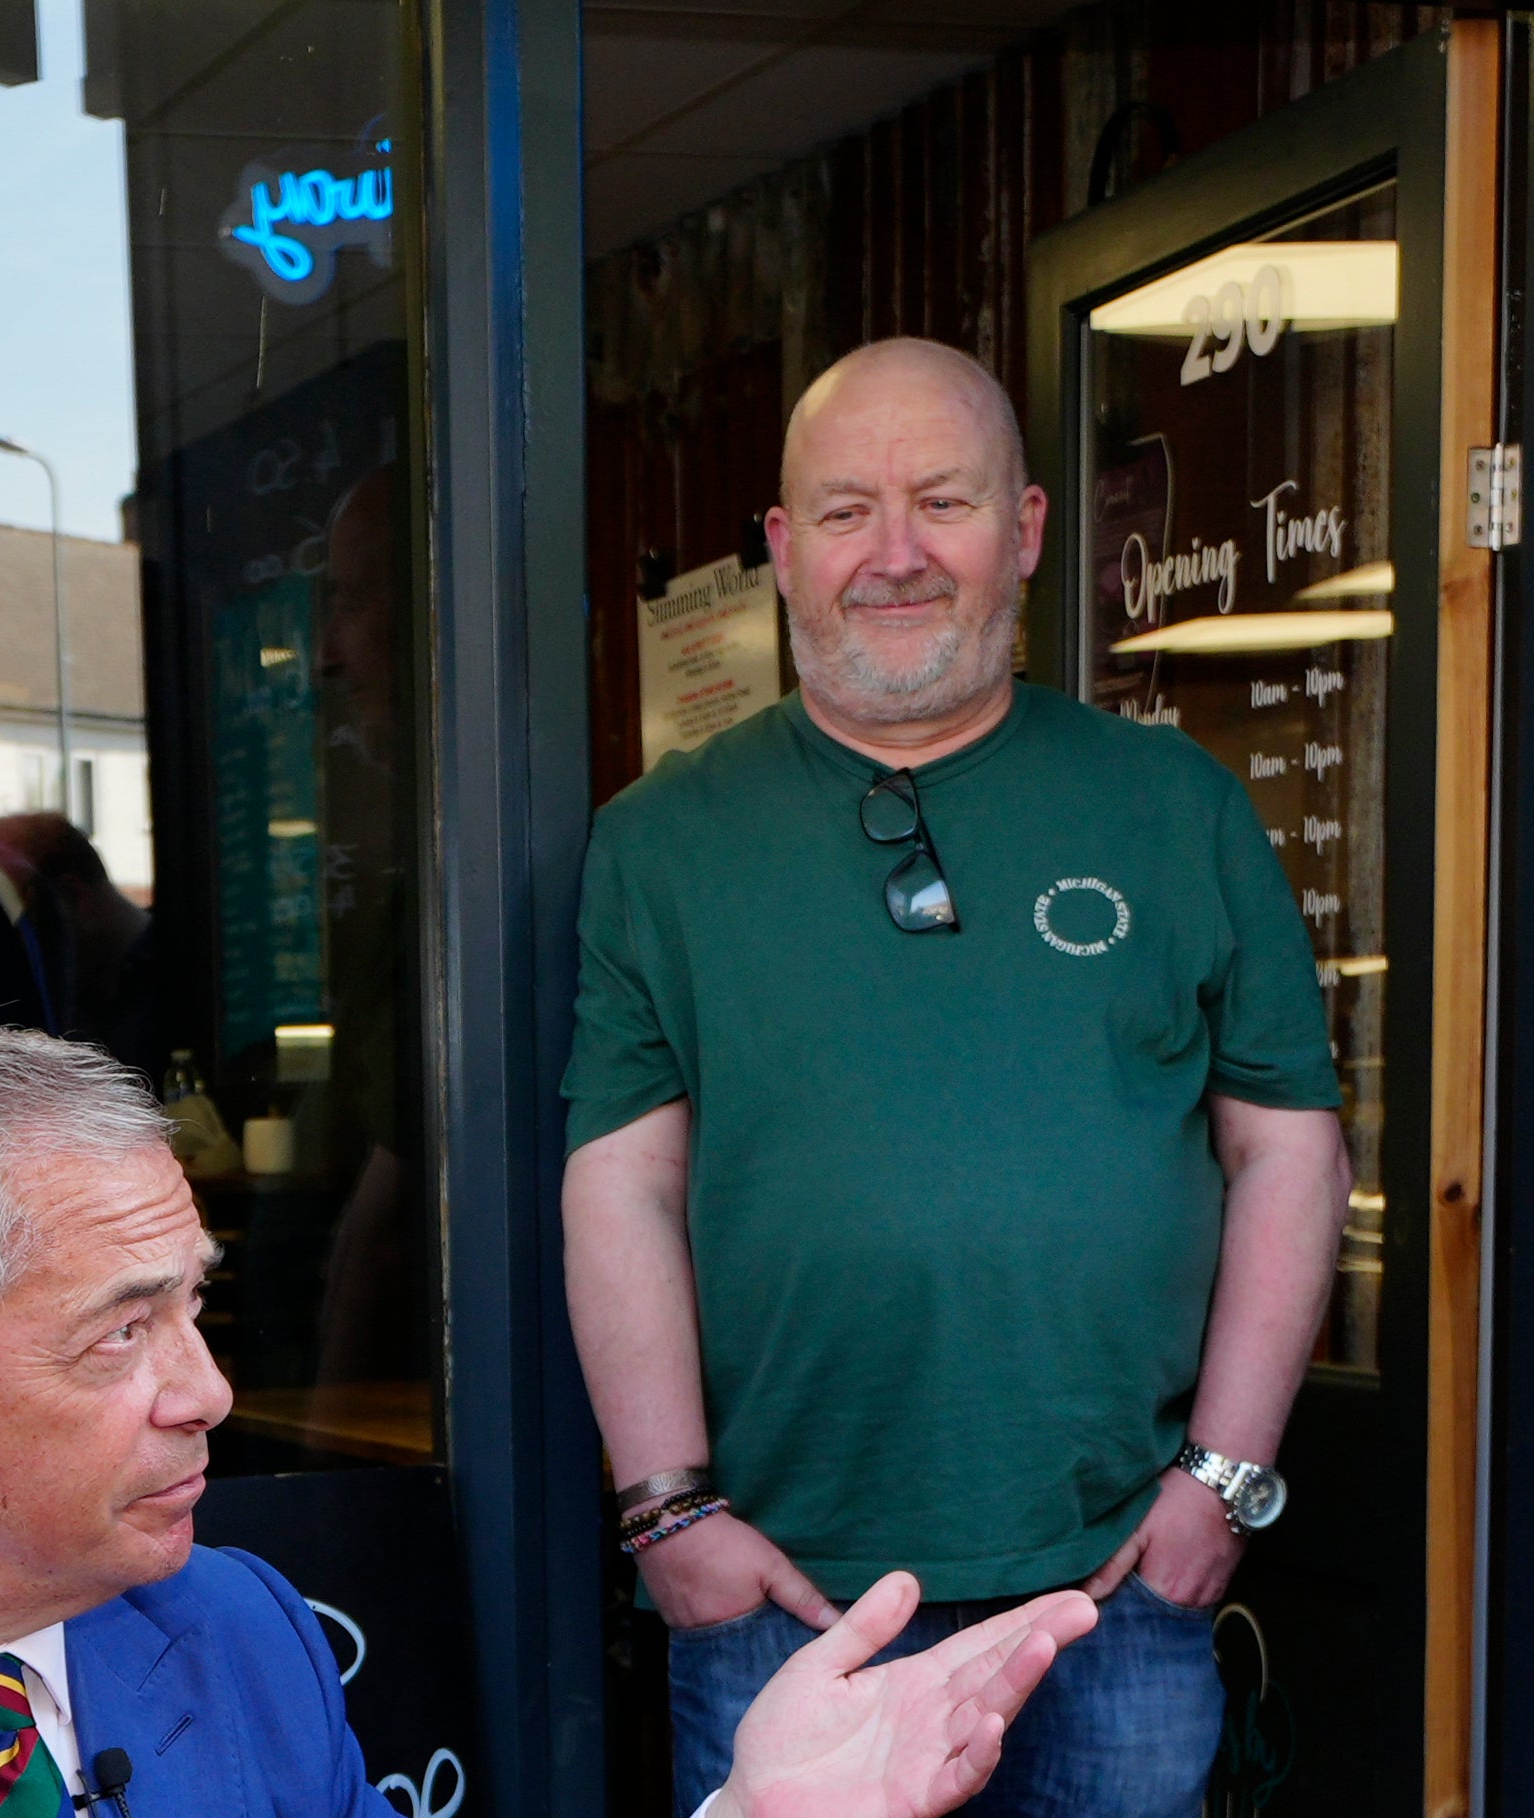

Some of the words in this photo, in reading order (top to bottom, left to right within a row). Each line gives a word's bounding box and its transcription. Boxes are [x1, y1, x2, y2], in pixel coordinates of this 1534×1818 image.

[1180, 264, 1283, 386] 290
[1121, 532, 1242, 624] Opening
[1250, 480, 1347, 584] Times
[1250, 680, 1288, 709] 10am
[1305, 666, 1344, 708] 10pm
[1249, 752, 1286, 780] 10am
[1303, 741, 1343, 781] 10pm
[1302, 816, 1341, 856] 10pm
